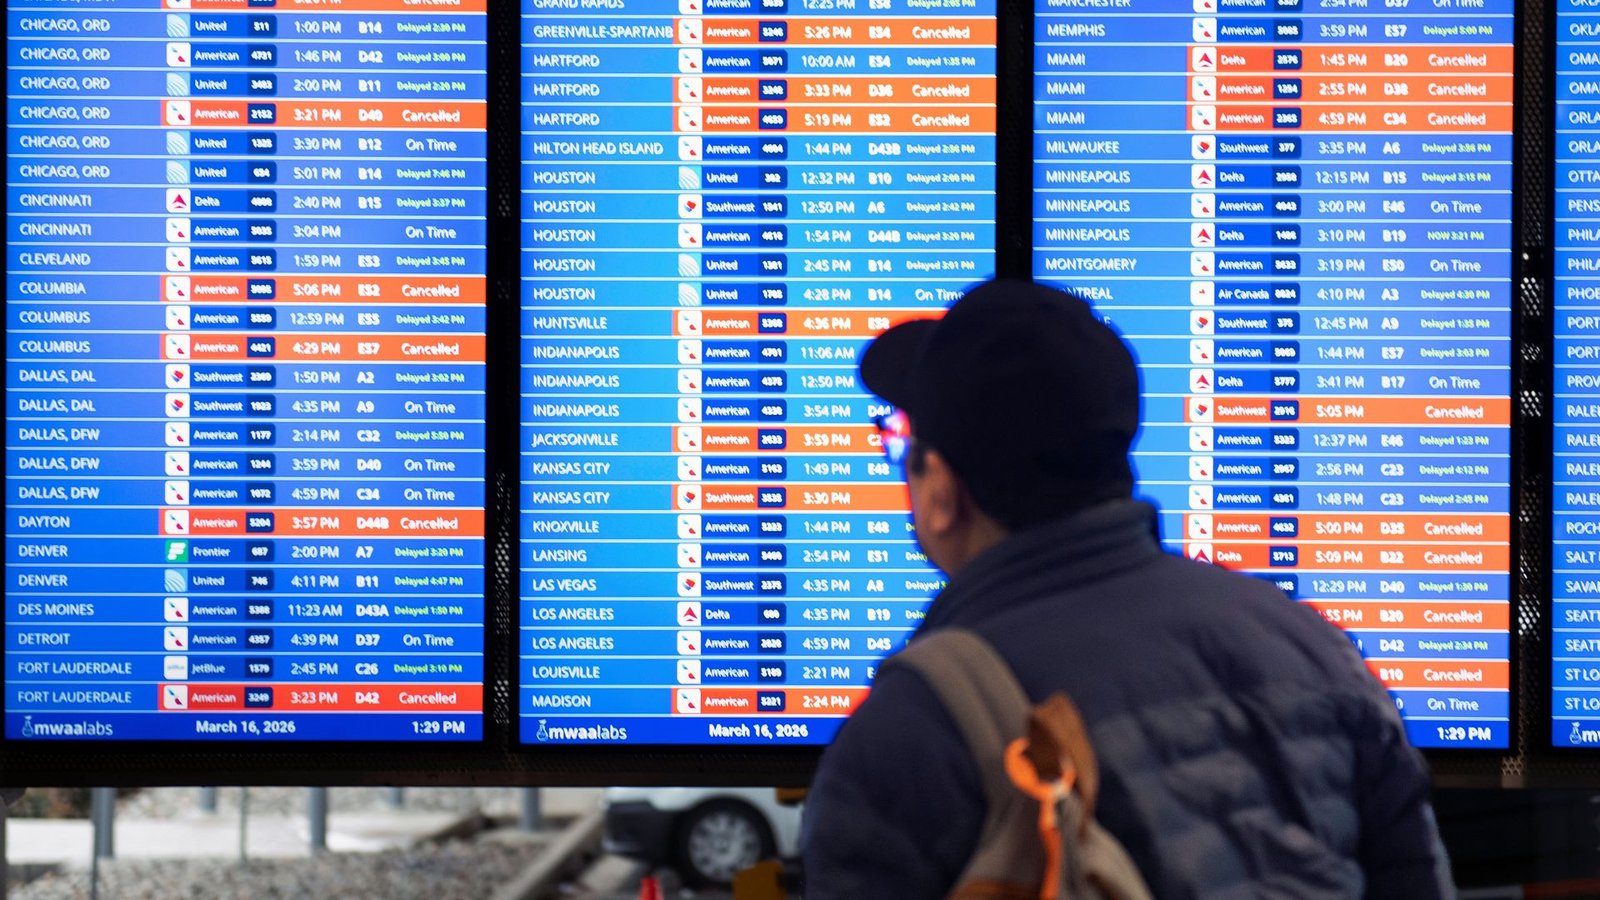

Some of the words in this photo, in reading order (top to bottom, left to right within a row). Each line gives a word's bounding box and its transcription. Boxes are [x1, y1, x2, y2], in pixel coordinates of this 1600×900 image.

[21, 19, 80, 32] CHICAGO,
[82, 19, 110, 31] ORD
[195, 21, 227, 31] United
[295, 21, 320, 33] 1:00
[322, 21, 341, 33] PM
[359, 22, 382, 33] B14
[706, 27, 750, 37] American
[805, 26, 830, 38] 5:26
[833, 26, 852, 38] PM
[912, 26, 970, 39] Cancelled
[1048, 24, 1105, 36] MEMPHIS
[1320, 25, 1345, 36] 3:59
[1348, 25, 1367, 37] PM
[1385, 25, 1407, 37] E57
[20, 107, 80, 120] CHICAGO,
[82, 107, 110, 119] ORD
[195, 109, 239, 118] American
[294, 109, 318, 121] 3:21
[322, 109, 341, 121] PM
[359, 109, 383, 121] D40
[402, 110, 460, 122] Cancelled
[534, 142, 579, 154] HILTON
[583, 142, 616, 154] HEAD
[619, 143, 663, 154] ISLAND
[706, 144, 750, 154] American
[806, 143, 830, 154] 1:44
[832, 143, 851, 154] PM
[869, 143, 901, 155] D43B
[1047, 141, 1119, 153] MILWAUKEE
[1220, 143, 1268, 153] Southwest
[1319, 142, 1344, 154] 3:35
[1347, 142, 1366, 154] PM
[1383, 142, 1400, 154] A6
[534, 201, 595, 212] HOUSTON
[707, 202, 755, 212] Southwest
[802, 201, 833, 213] 12:50
[836, 201, 855, 213] PM
[868, 201, 885, 213] A6
[20, 224, 91, 235] CINCINNATI
[194, 226, 239, 236] American
[294, 225, 319, 237] 3:04
[322, 226, 341, 237] PM
[406, 226, 424, 238] On
[426, 226, 456, 238] Time
[1046, 229, 1130, 241] MINNEAPOLIS
[1220, 230, 1244, 240] Delta
[1318, 230, 1343, 241] 3:10
[1346, 230, 1365, 241] PM
[1383, 230, 1406, 242] B19
[1428, 232, 1450, 240] NOW
[1451, 232, 1468, 240] 3:21
[1470, 232, 1484, 240] PM
[1219, 289, 1233, 299] Air
[1234, 289, 1269, 299] Canada
[1317, 288, 1343, 300] 4:10
[1346, 288, 1364, 300] PM
[1382, 288, 1399, 300] A3
[1421, 290, 1455, 300] Delayed
[1476, 290, 1490, 299] PM
[20, 341, 90, 352] COLUMBUS
[194, 343, 239, 352] American
[293, 342, 319, 354] 4:29
[321, 342, 340, 354] PM
[358, 342, 380, 354] E57
[401, 343, 459, 355] Cancelled
[534, 375, 619, 387] INDIANAPOLIS
[801, 376, 833, 388] 12:50
[835, 376, 854, 387] PM
[1218, 406, 1266, 415] Southwest
[1317, 405, 1342, 417] 5:05
[1344, 405, 1364, 417] PM
[1425, 406, 1483, 418] Cancelled
[532, 434, 618, 447] JACKSONVILLE
[706, 435, 749, 444] American
[804, 434, 829, 446] 3:59
[831, 434, 850, 446] PM
[19, 516, 70, 527] DAYTON
[193, 518, 237, 527] American
[293, 517, 318, 528] 3:57
[320, 517, 339, 528] PM
[357, 517, 389, 529] D44B
[400, 517, 458, 529] Cancelled
[533, 521, 599, 533] KNOXVILLE
[705, 522, 749, 532] American
[804, 521, 829, 533] 1:44
[831, 521, 850, 533] PM
[868, 521, 889, 533] E48
[1217, 523, 1261, 532] American
[1316, 522, 1342, 534] 5:00
[1344, 522, 1363, 533] PM
[1424, 523, 1483, 535] Cancelled
[1566, 551, 1595, 563] SALT
[19, 575, 67, 586] DENVER
[193, 576, 224, 585] United
[291, 576, 315, 587] 4:11
[320, 576, 339, 587] PM
[356, 576, 378, 587] B11
[395, 577, 429, 587] Delayed
[430, 577, 448, 585] 4:47
[449, 577, 463, 585] PM
[533, 608, 556, 620] LOS
[558, 608, 614, 620] ANGELES
[706, 609, 730, 619] Delta
[803, 608, 828, 620] 4:35
[831, 609, 850, 620] PM
[868, 609, 890, 620] B19
[19, 662, 49, 673] FORT
[53, 663, 131, 674] LAUDERDALE
[192, 664, 225, 674] JetBlue
[291, 663, 316, 674] 2:45
[319, 663, 338, 674] PM
[355, 663, 378, 674] C26
[394, 664, 428, 674] Delayed
[449, 664, 462, 672] PM
[1566, 669, 1581, 680] ST
[533, 695, 591, 707] MADISON
[705, 697, 748, 706] American
[803, 696, 828, 707] 2:24
[831, 696, 850, 707] PM
[1427, 698, 1446, 710] On
[1448, 698, 1479, 710] Time
[1566, 698, 1580, 709] ST
[35, 722, 112, 735] mwaalabs
[196, 721, 237, 732] March
[241, 721, 259, 735] 16,
[264, 721, 295, 733] 2026
[413, 721, 440, 733] 1:29
[443, 721, 465, 733] PM
[549, 725, 627, 739] mwaalabs
[709, 724, 750, 737] March
[754, 724, 772, 739] 16,
[776, 724, 808, 737] 2026
[1437, 727, 1465, 740] 1:29
[1468, 727, 1491, 740] PM
